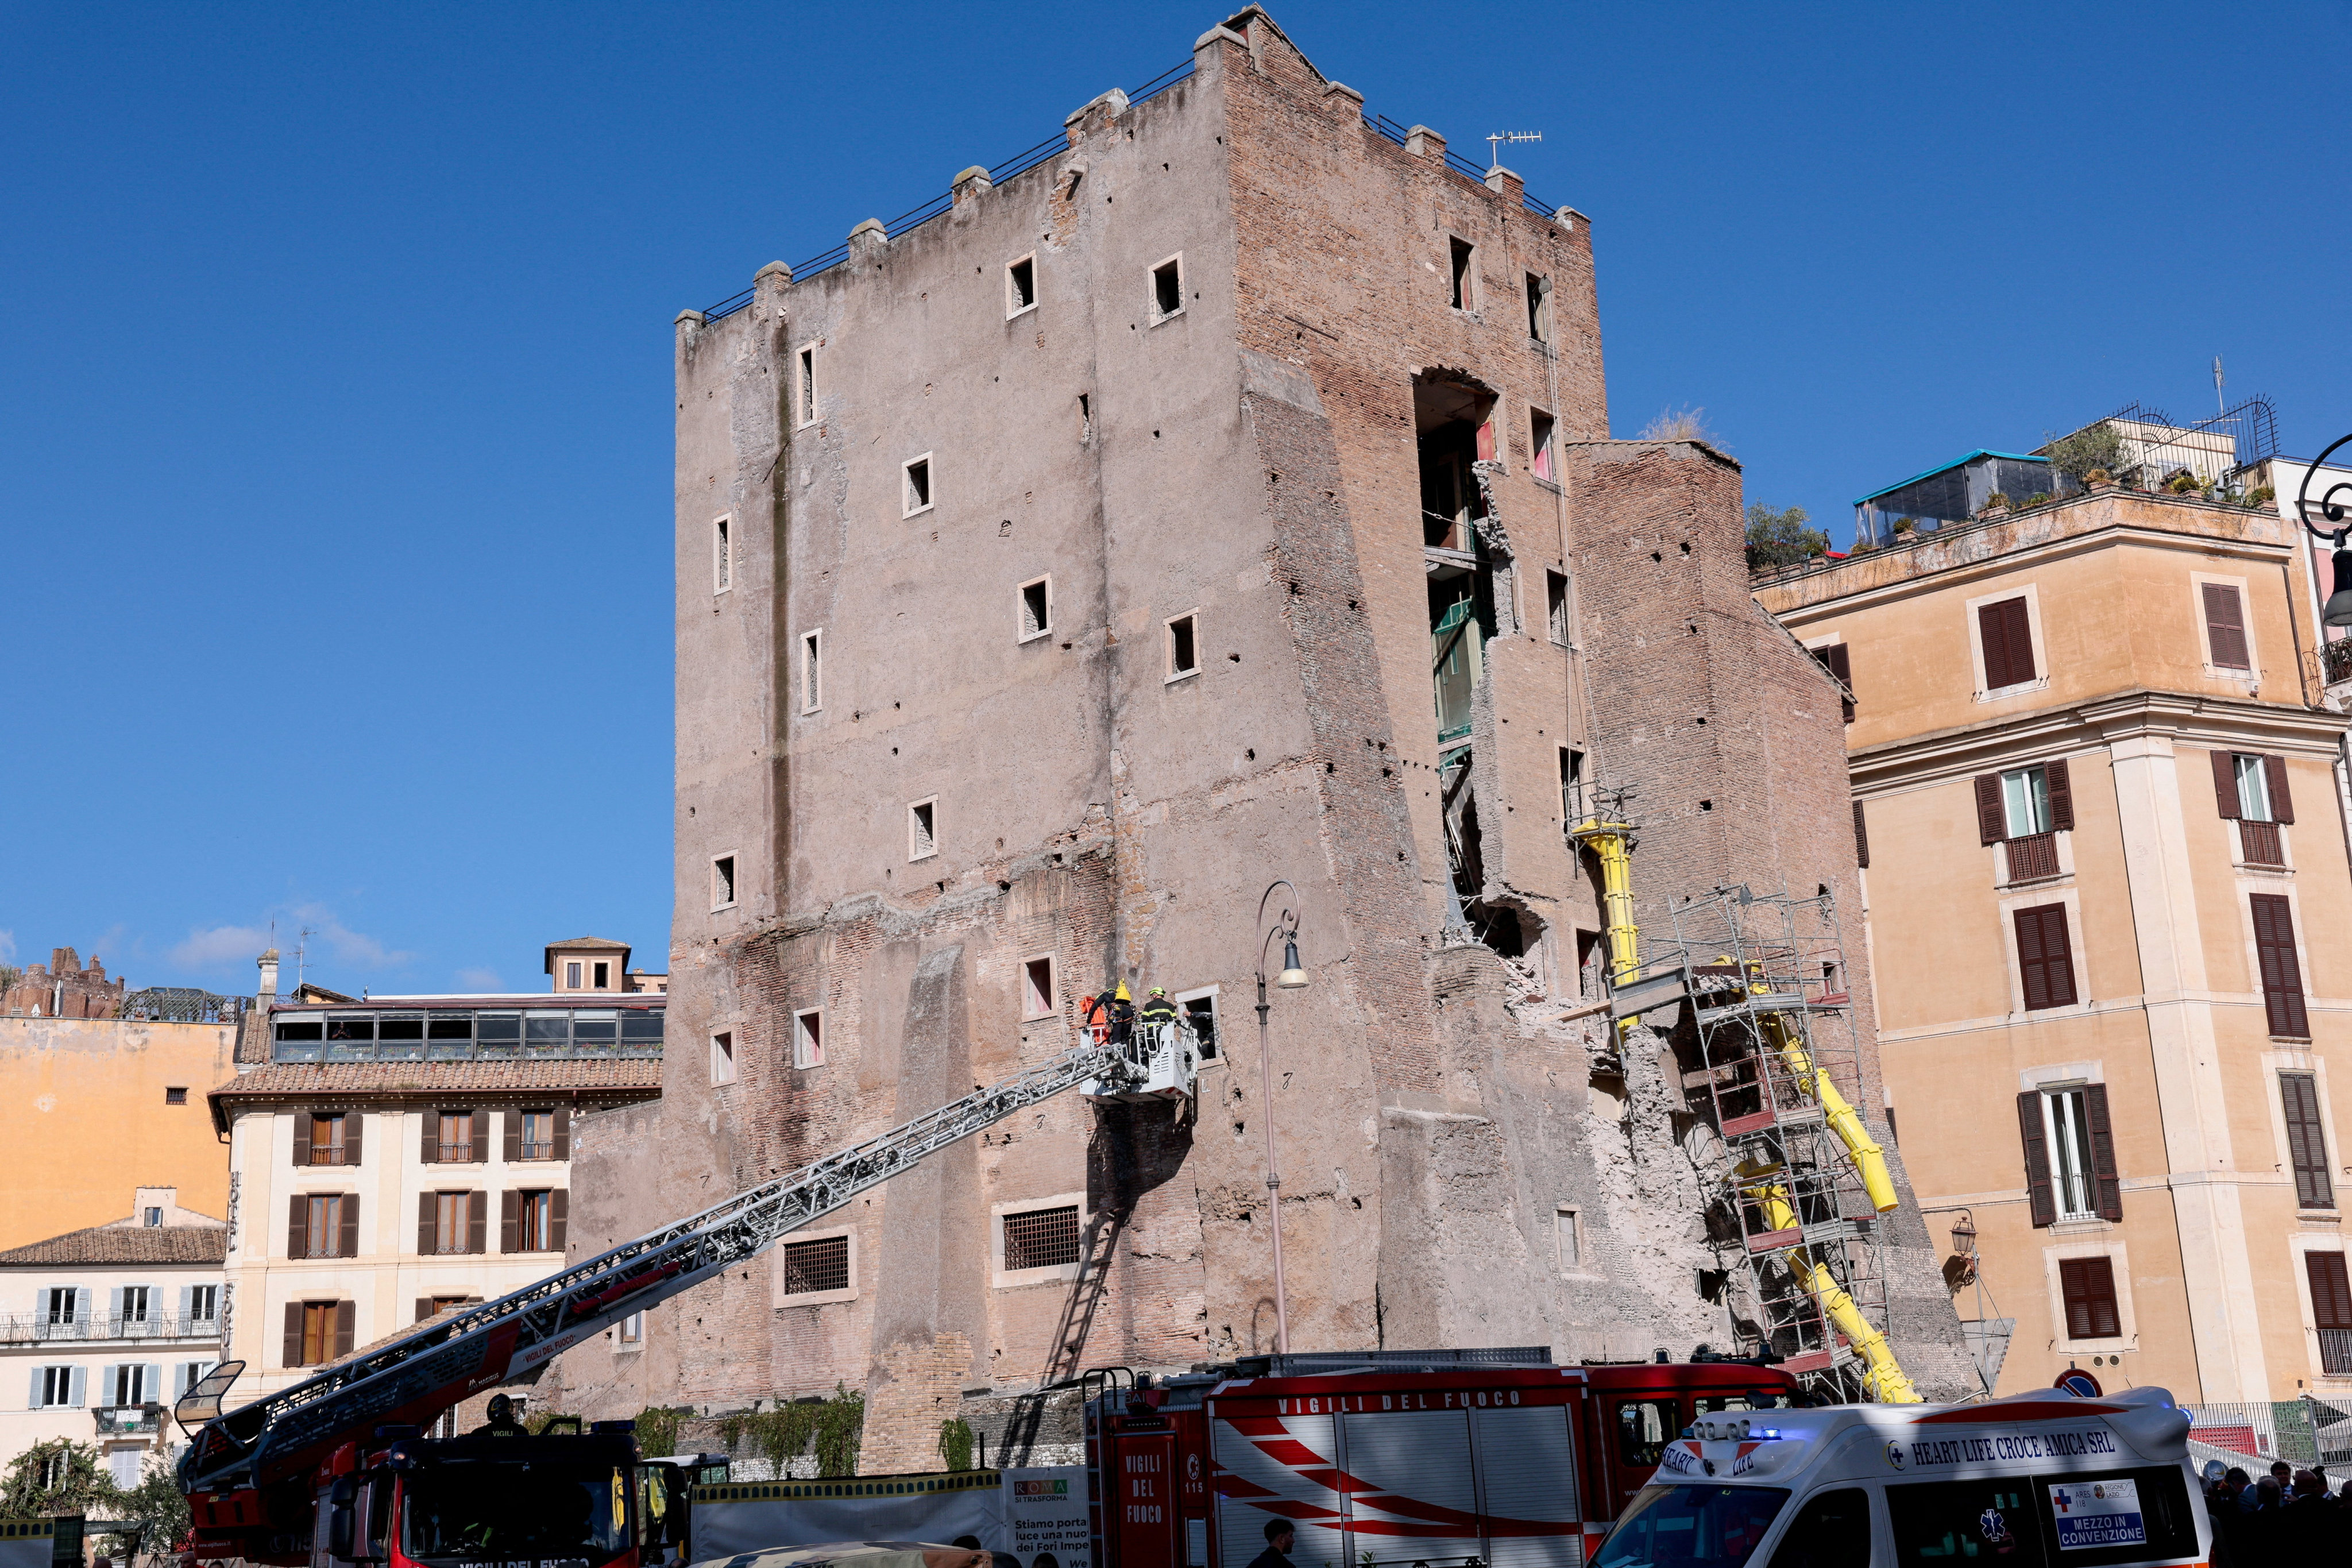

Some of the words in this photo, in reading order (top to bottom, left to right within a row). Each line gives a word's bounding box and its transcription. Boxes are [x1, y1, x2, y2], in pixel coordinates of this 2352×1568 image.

[226, 1171, 239, 1252] HOTEL
[219, 1281, 233, 1363] FORUM
[525, 1352, 542, 1363] VIGILI
[543, 1345, 554, 1355] DEL
[555, 1335, 574, 1350] FUOCO
[478, 1372, 499, 1387] MAGIRUS
[1125, 1392, 1145, 1404] BAI
[1278, 1396, 1363, 1414] VIGILI
[1382, 1394, 1427, 1410] DEL
[1445, 1391, 1519, 1407] FUOCO
[1911, 1440, 1960, 1466] HEART
[1961, 1438, 1995, 1462] LIFE
[1996, 1435, 2042, 1460] CROCE
[2044, 1432, 2088, 1457] AMICA
[2087, 1431, 2115, 1454] SRL
[1126, 1455, 1160, 1473] VIGILI
[1662, 1447, 1696, 1474] HEART
[1733, 1451, 1754, 1476] LIFE
[1016, 1482, 1065, 1493] ROMA
[1133, 1480, 1154, 1497] DEL
[1185, 1482, 1203, 1493] 115
[2075, 1490, 2091, 1499] ARES
[1127, 1505, 1161, 1523] FUOCO
[1015, 1519, 1054, 1530] Stiamo
[2073, 1517, 2112, 1530] MEZZO
[2114, 1516, 2126, 1527] IN
[1015, 1532, 1039, 1540] luce
[1042, 1532, 1062, 1540] una
[1065, 1531, 1089, 1539] nuo
[2062, 1528, 2143, 1544] CONVENZIONE
[1017, 1542, 1033, 1552] dei
[1037, 1541, 1057, 1551] Fori
